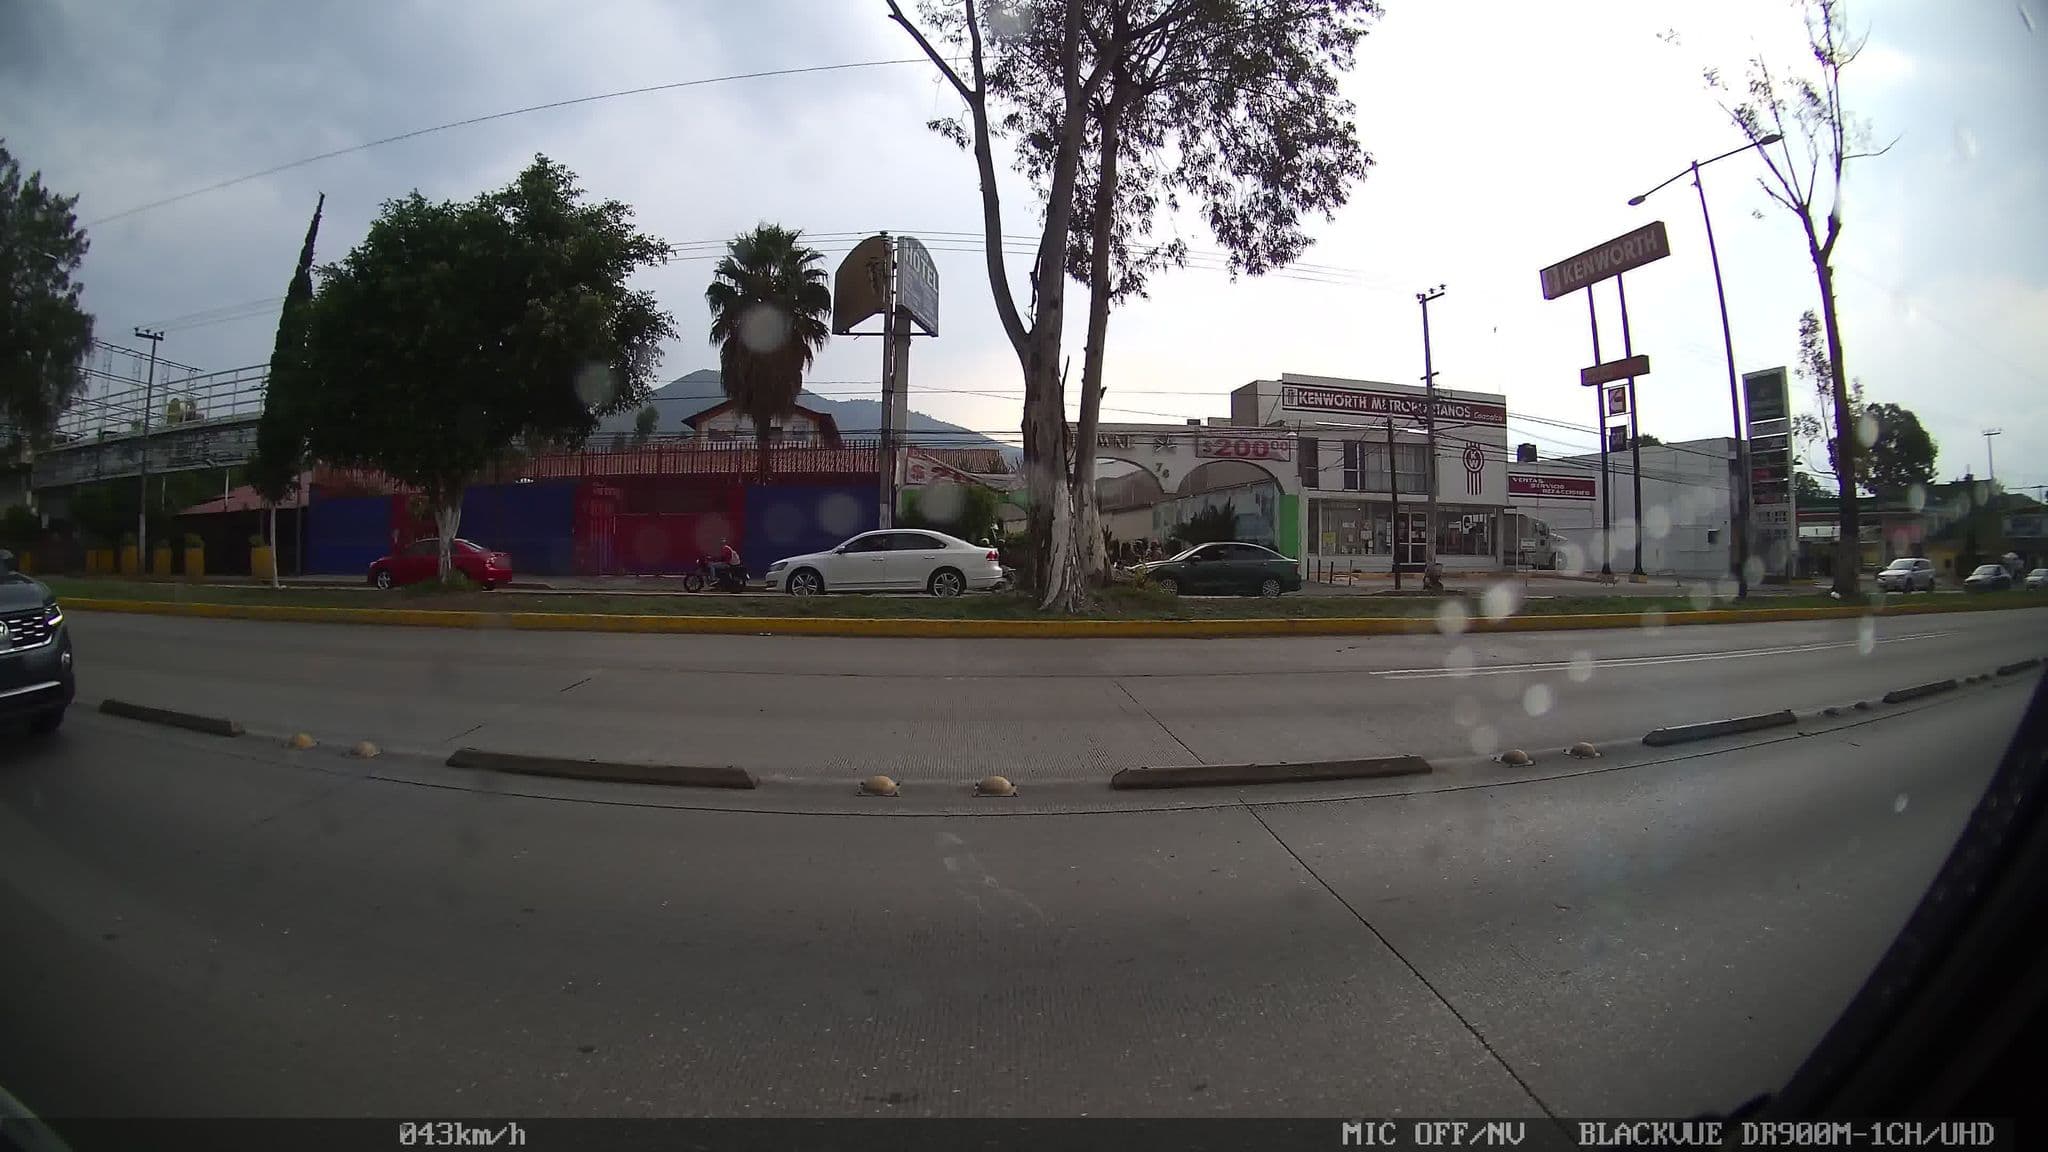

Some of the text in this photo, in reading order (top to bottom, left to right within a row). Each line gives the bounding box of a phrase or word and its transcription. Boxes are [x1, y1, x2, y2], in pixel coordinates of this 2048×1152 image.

[905, 241, 938, 293] HOTEL
[1562, 230, 1658, 284] KENWORTH
[1298, 391, 1368, 409] KENWORTH
[1371, 397, 1471, 418] METROPOITANOS
